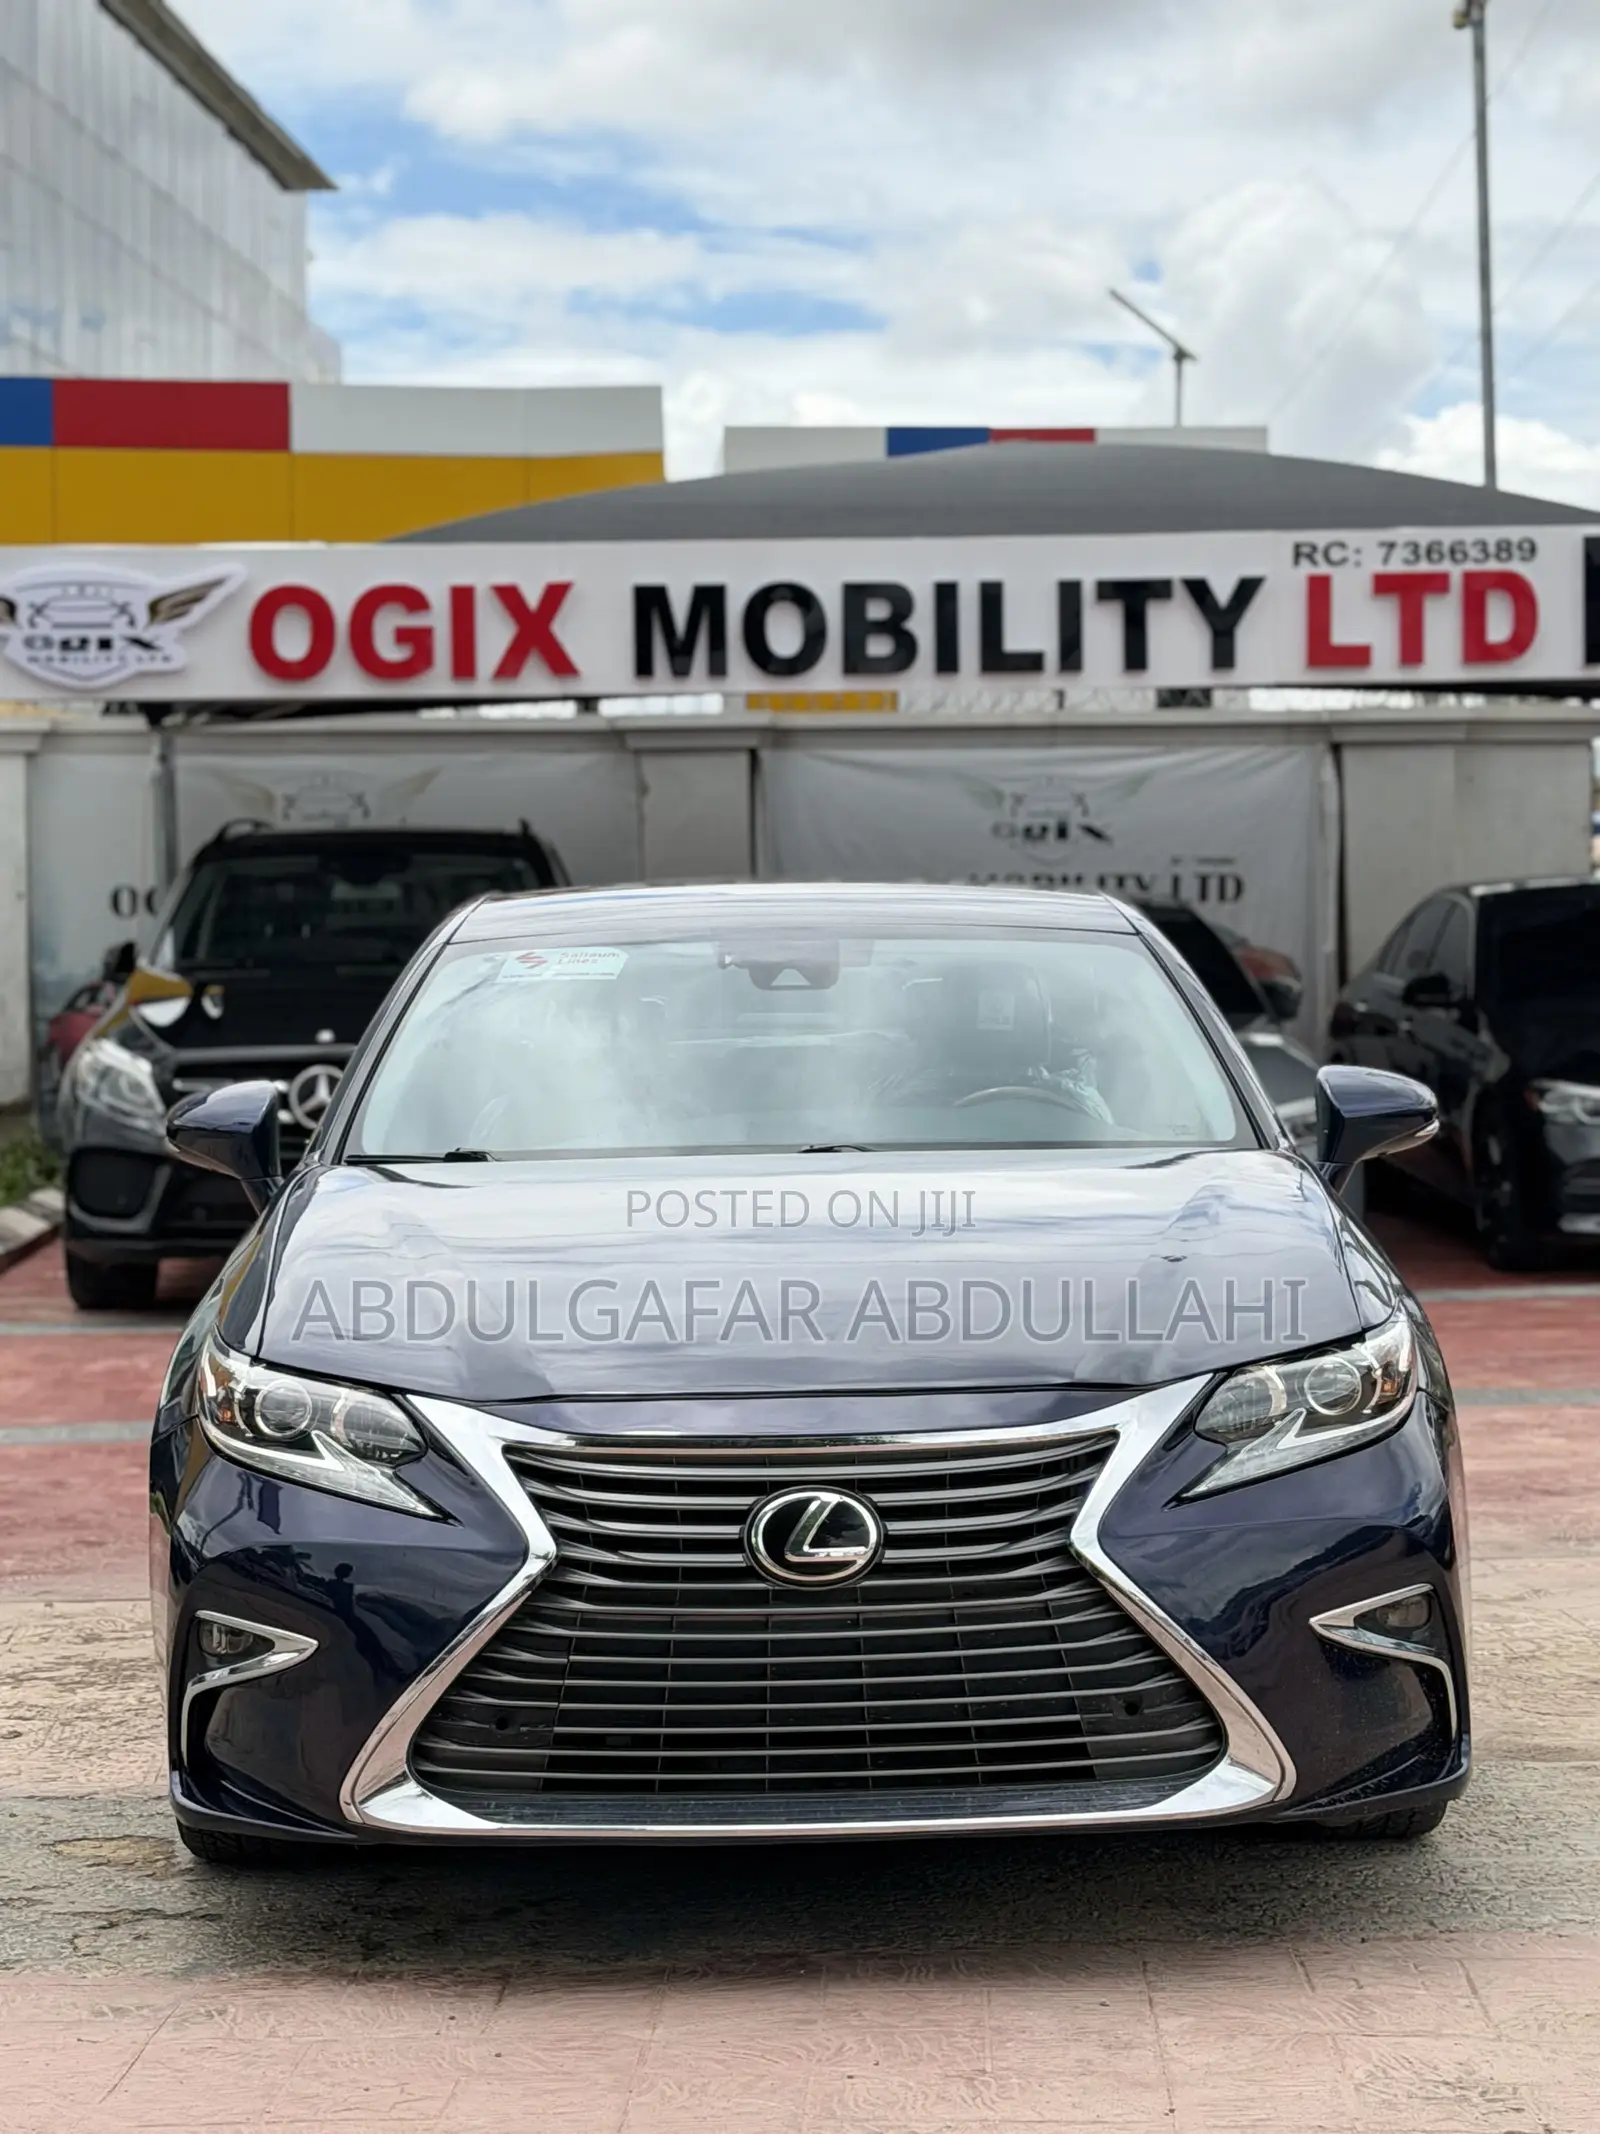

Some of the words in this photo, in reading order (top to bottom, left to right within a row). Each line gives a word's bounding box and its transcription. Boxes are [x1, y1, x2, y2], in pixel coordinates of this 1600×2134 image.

[1292, 541, 1362, 568] RC:
[1377, 537, 1537, 566] 7366389
[249, 583, 580, 682] OGIX
[633, 576, 1266, 678] MOBILITY
[1306, 569, 1539, 668] LTD
